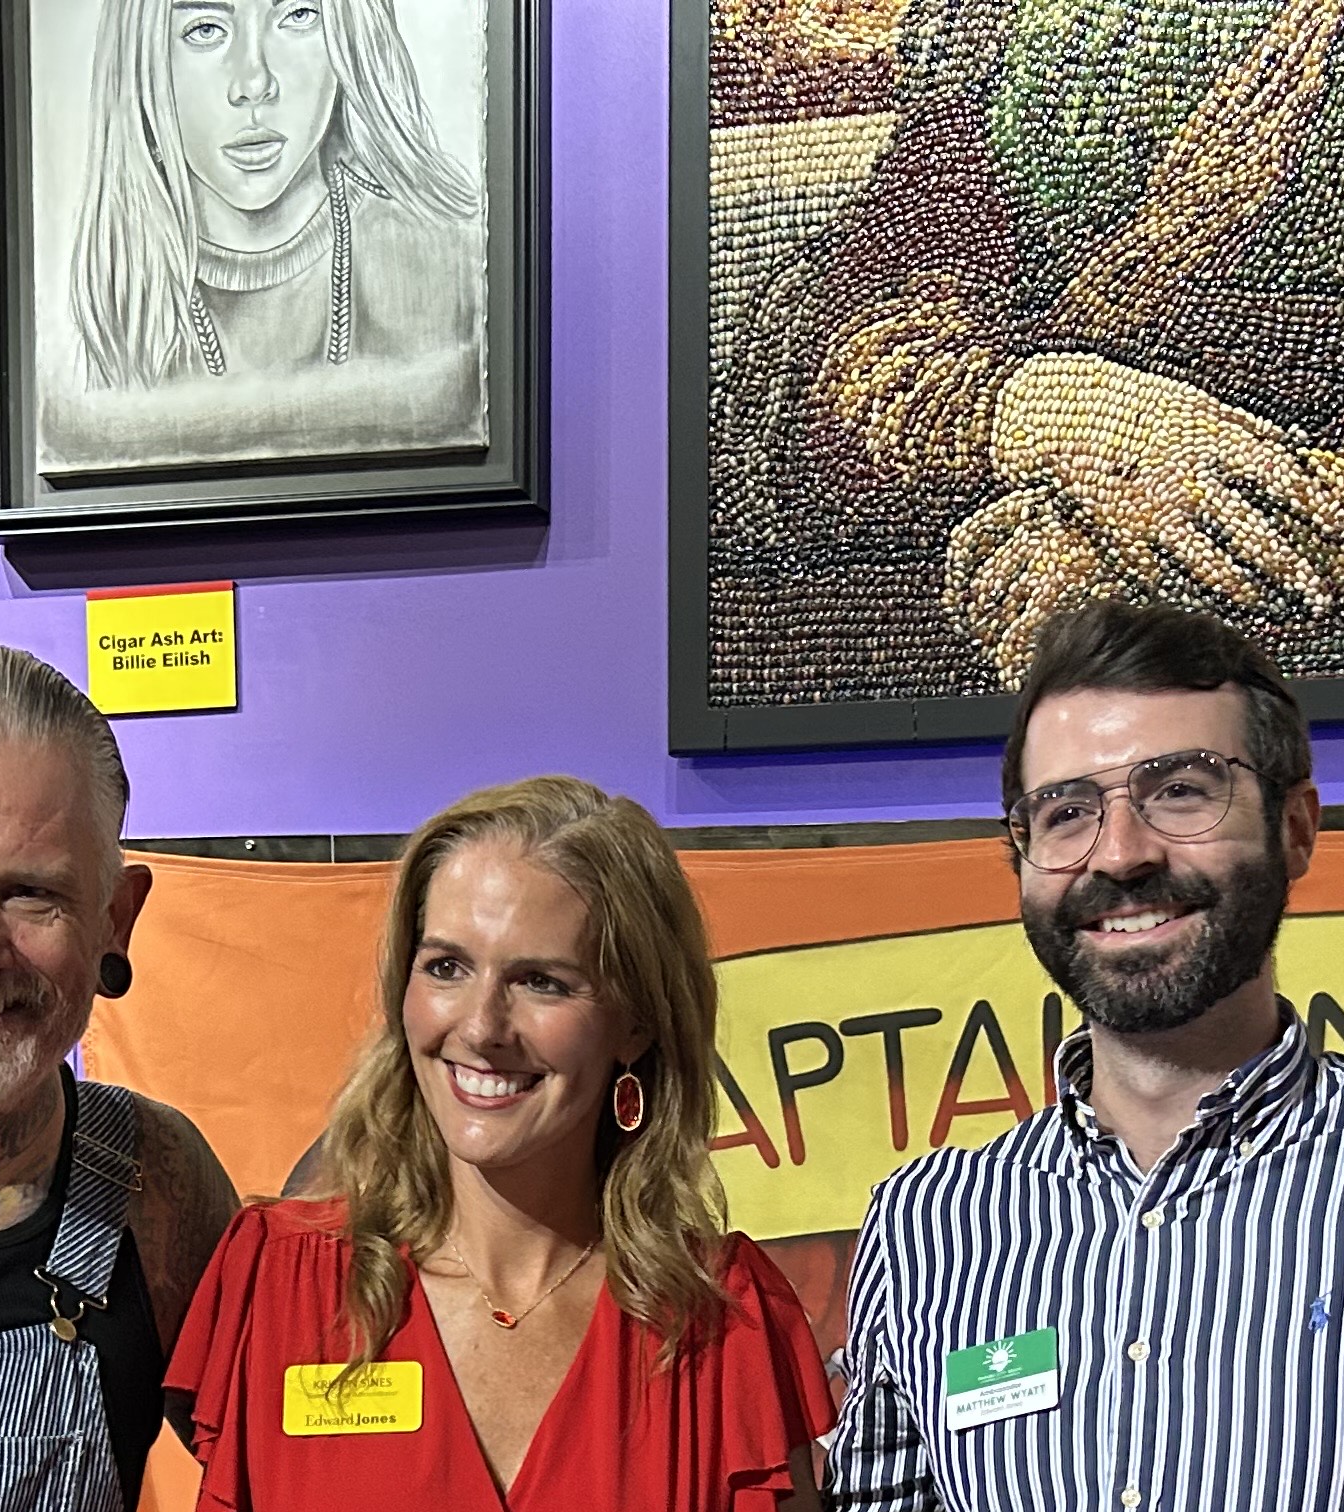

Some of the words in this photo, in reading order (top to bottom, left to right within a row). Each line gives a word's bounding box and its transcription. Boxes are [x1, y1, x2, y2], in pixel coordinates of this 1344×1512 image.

[99, 634, 146, 653] Cigar
[151, 630, 184, 647] Ash
[189, 628, 224, 645] Art:
[112, 654, 157, 670] Billie
[162, 650, 211, 668] Eilish
[956, 1395, 1006, 1414] MATTHEW
[1010, 1384, 1046, 1400] WYATT
